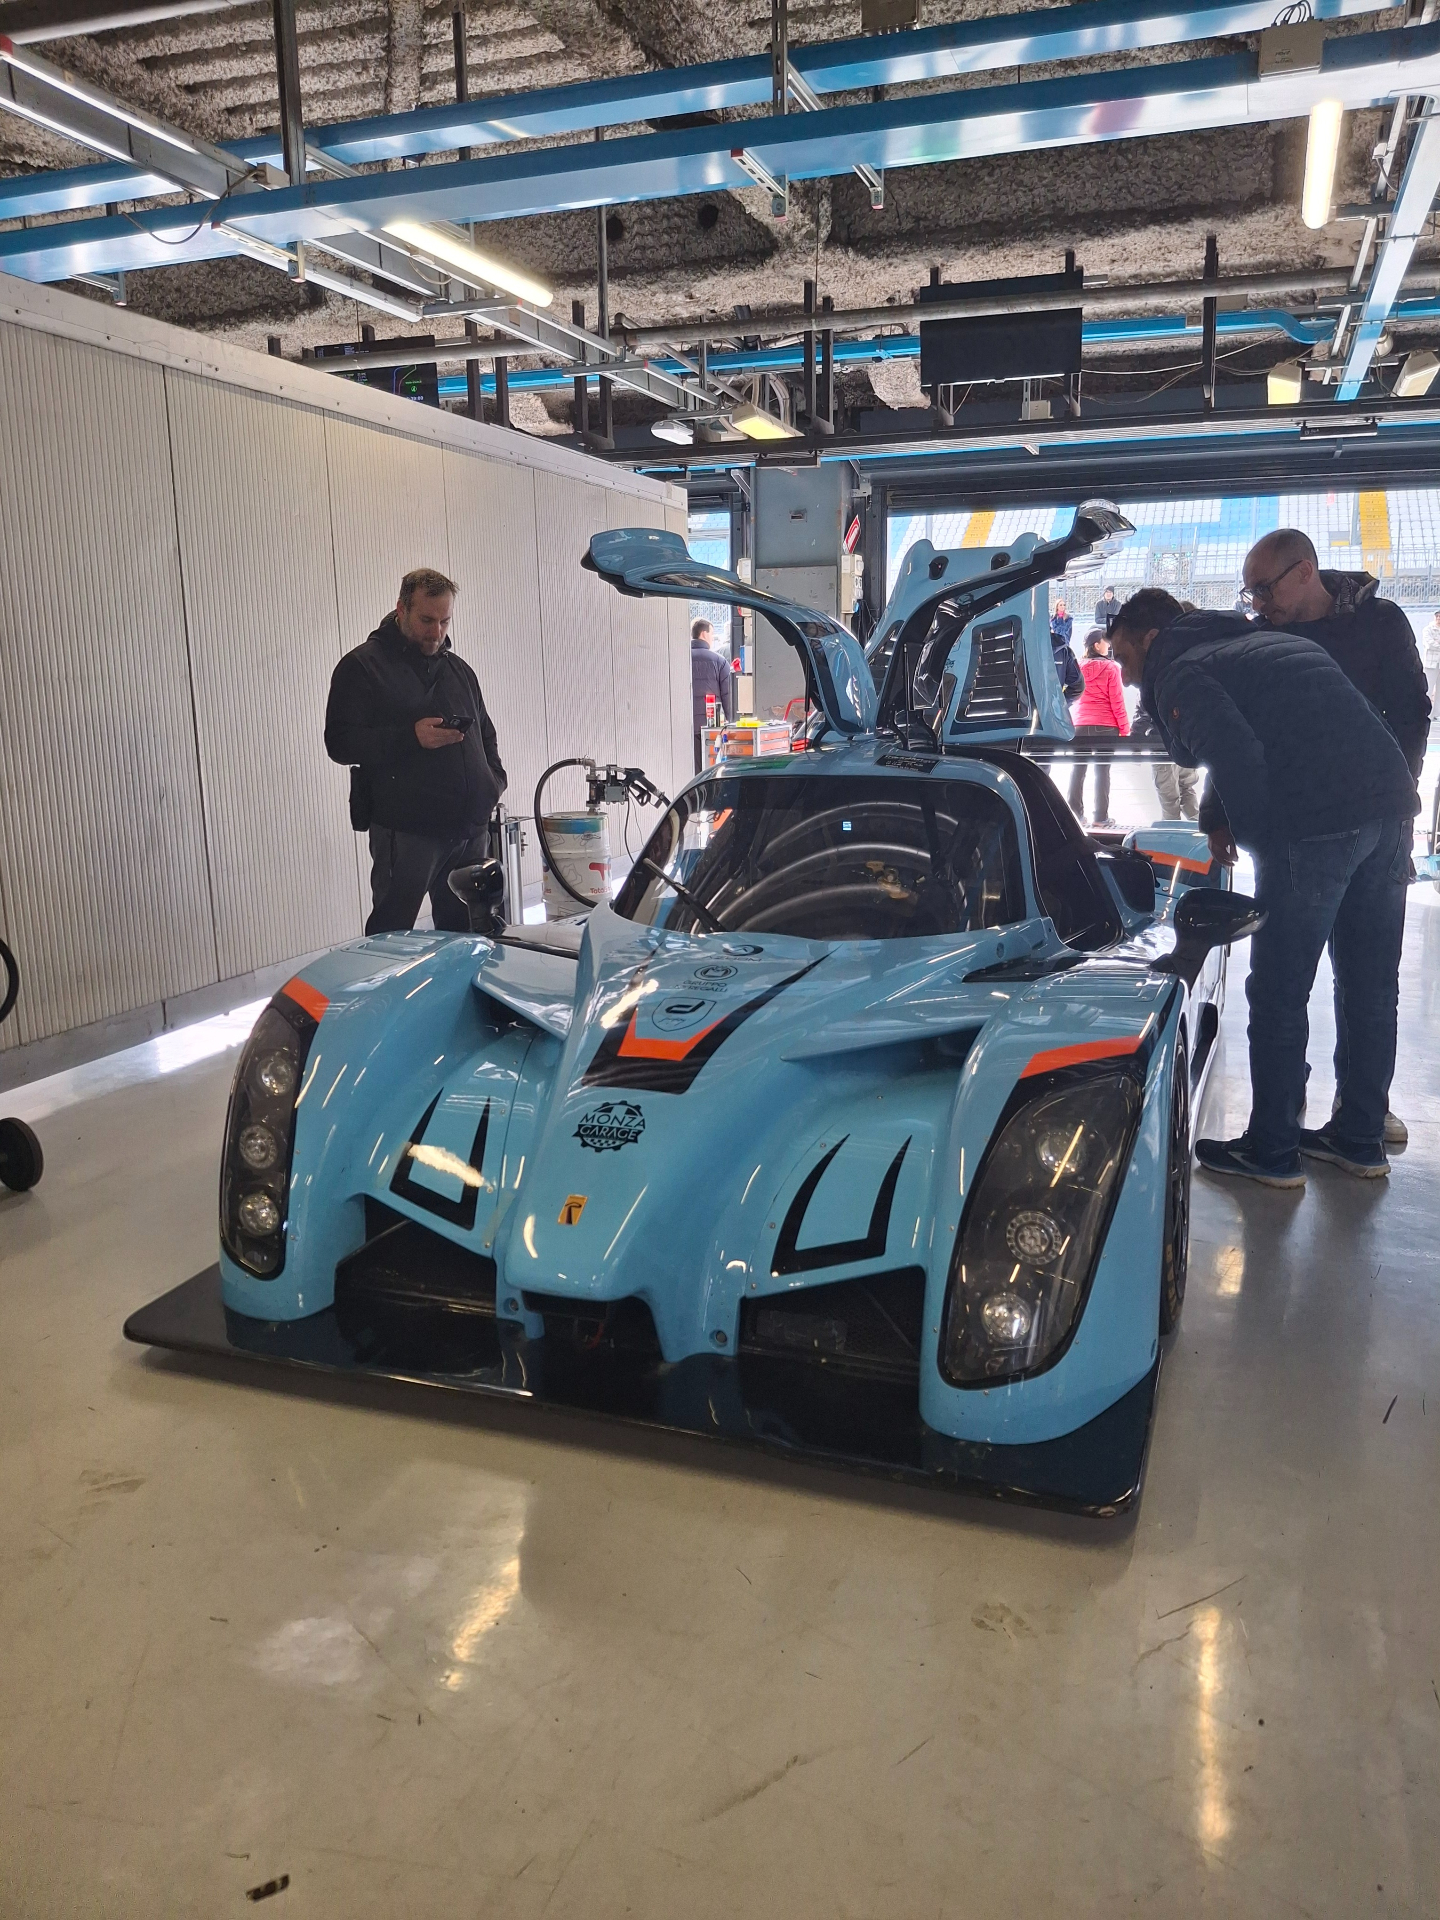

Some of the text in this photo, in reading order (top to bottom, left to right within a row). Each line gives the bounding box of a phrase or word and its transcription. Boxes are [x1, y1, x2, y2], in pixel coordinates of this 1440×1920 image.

[682, 980, 728, 988] GRUPPO
[579, 1112, 646, 1129] MONZA
[579, 1125, 638, 1140] GARAGE
